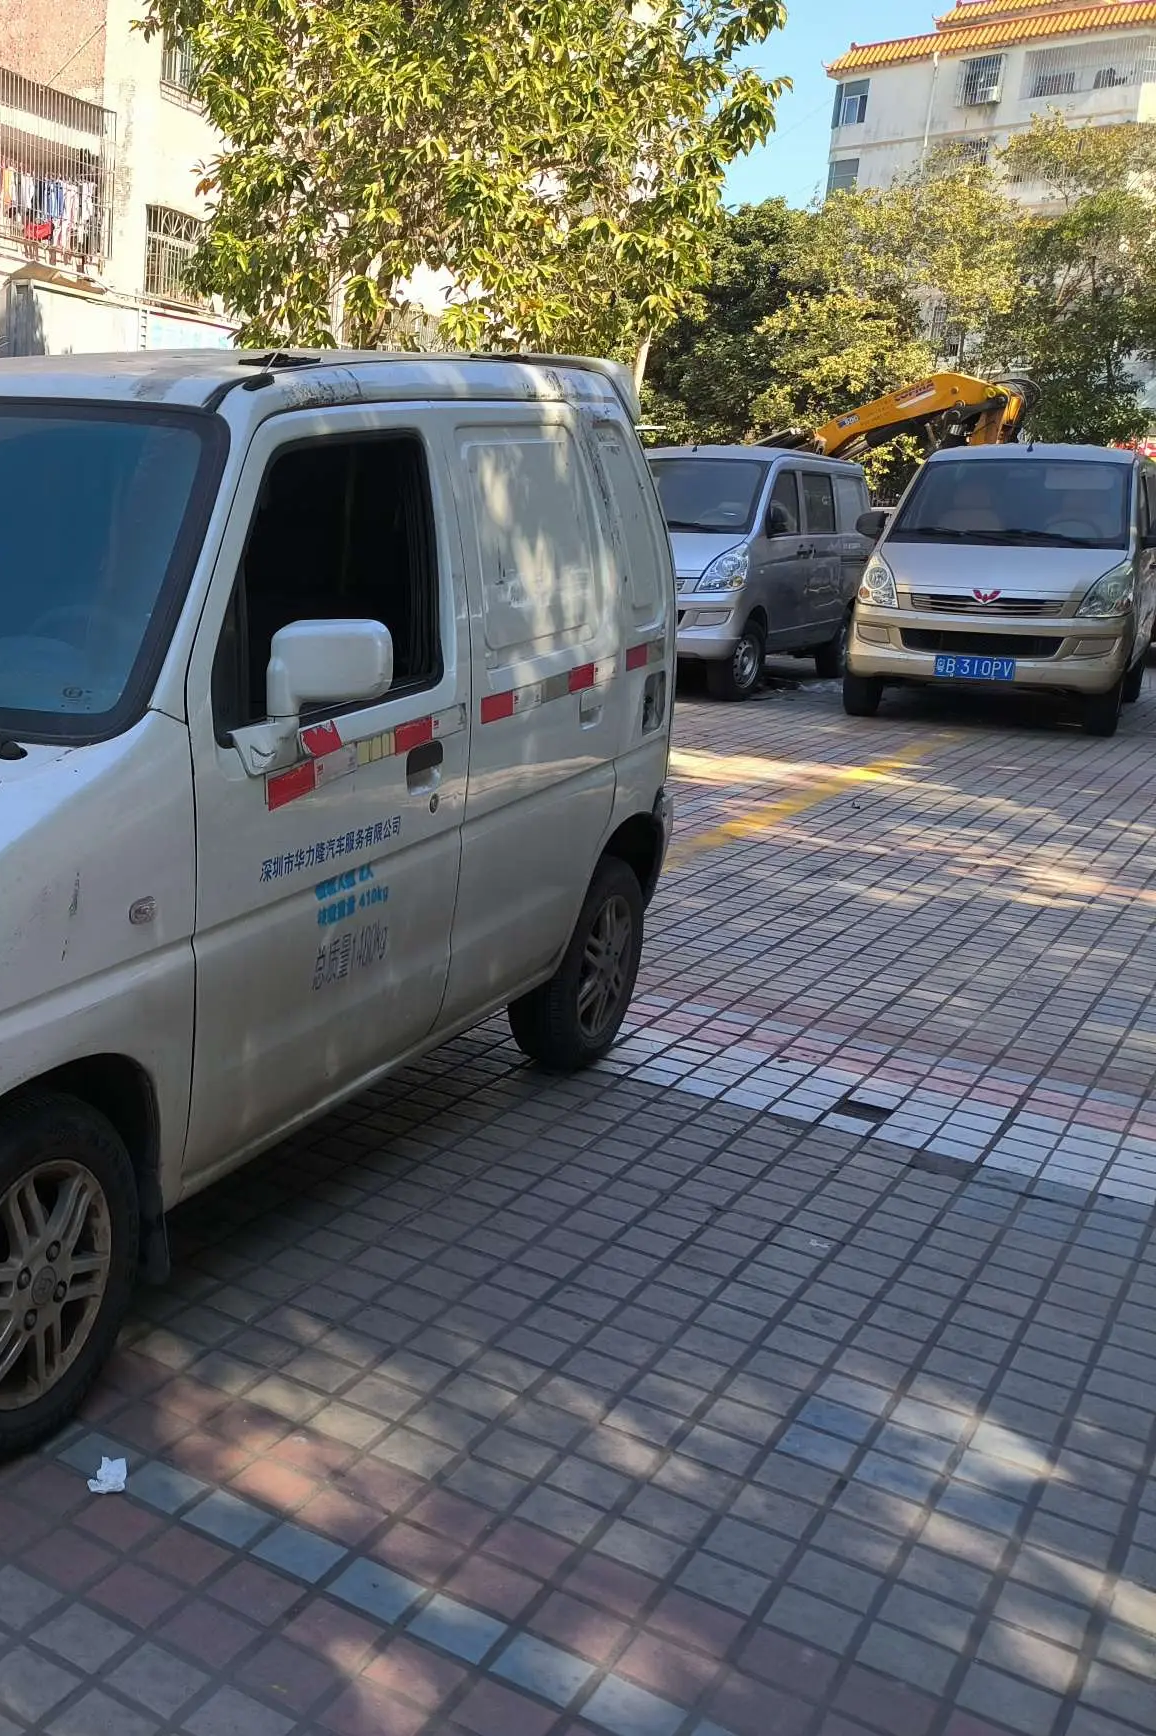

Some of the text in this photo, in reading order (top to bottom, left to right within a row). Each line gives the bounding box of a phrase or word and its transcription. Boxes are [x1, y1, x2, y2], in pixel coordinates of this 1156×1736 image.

[259, 815, 402, 883] 深圳市华力隆汽车服务有限公司
